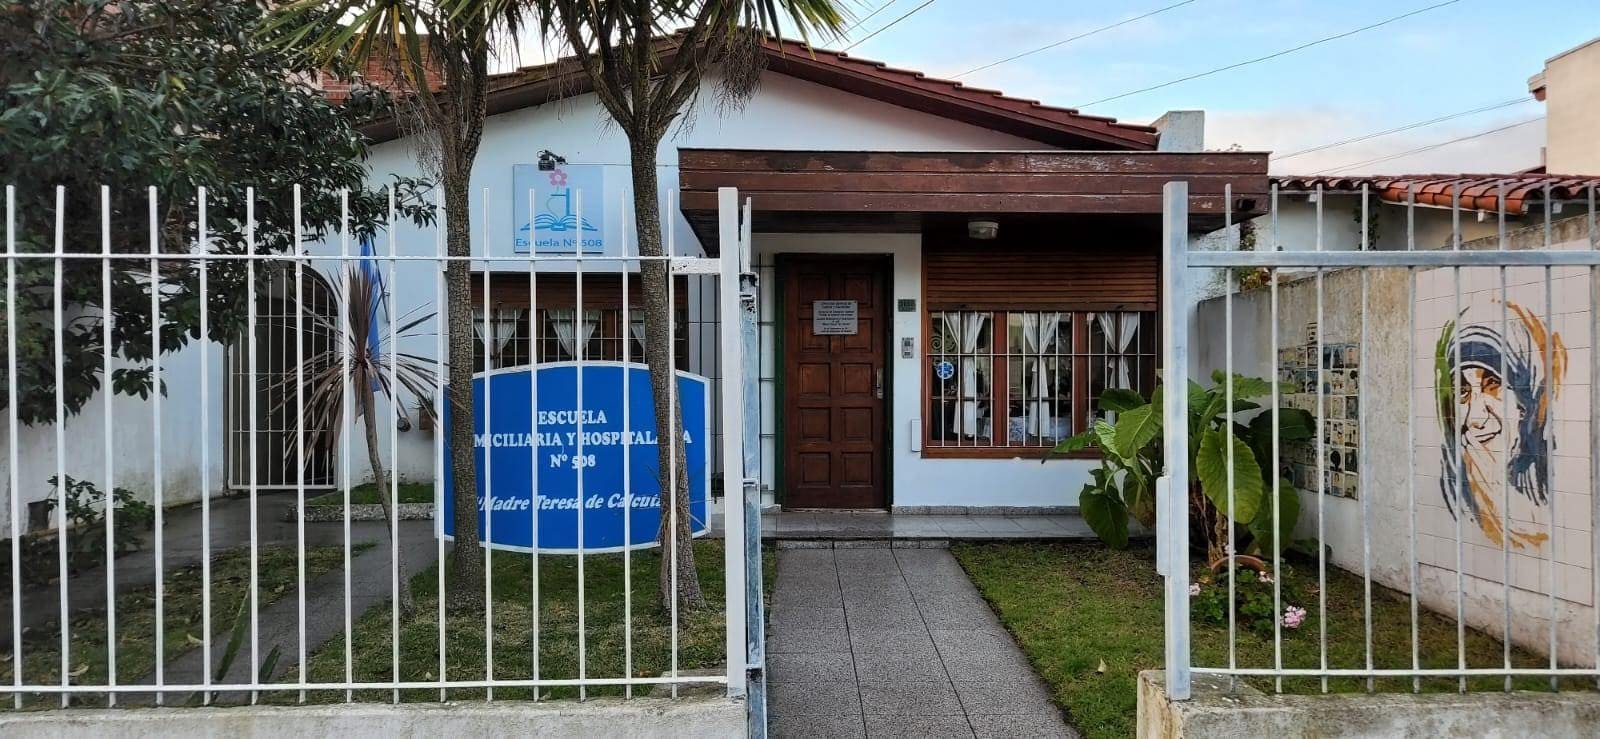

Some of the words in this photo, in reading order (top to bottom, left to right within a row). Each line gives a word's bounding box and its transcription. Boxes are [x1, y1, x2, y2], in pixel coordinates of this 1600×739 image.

[515, 238, 560, 247] Esuela
[538, 410, 607, 425] ESCUELA
[566, 432, 576, 446] Y
[571, 454, 596, 469] 508
[536, 494, 581, 510] Teresa
[585, 494, 604, 509] de
